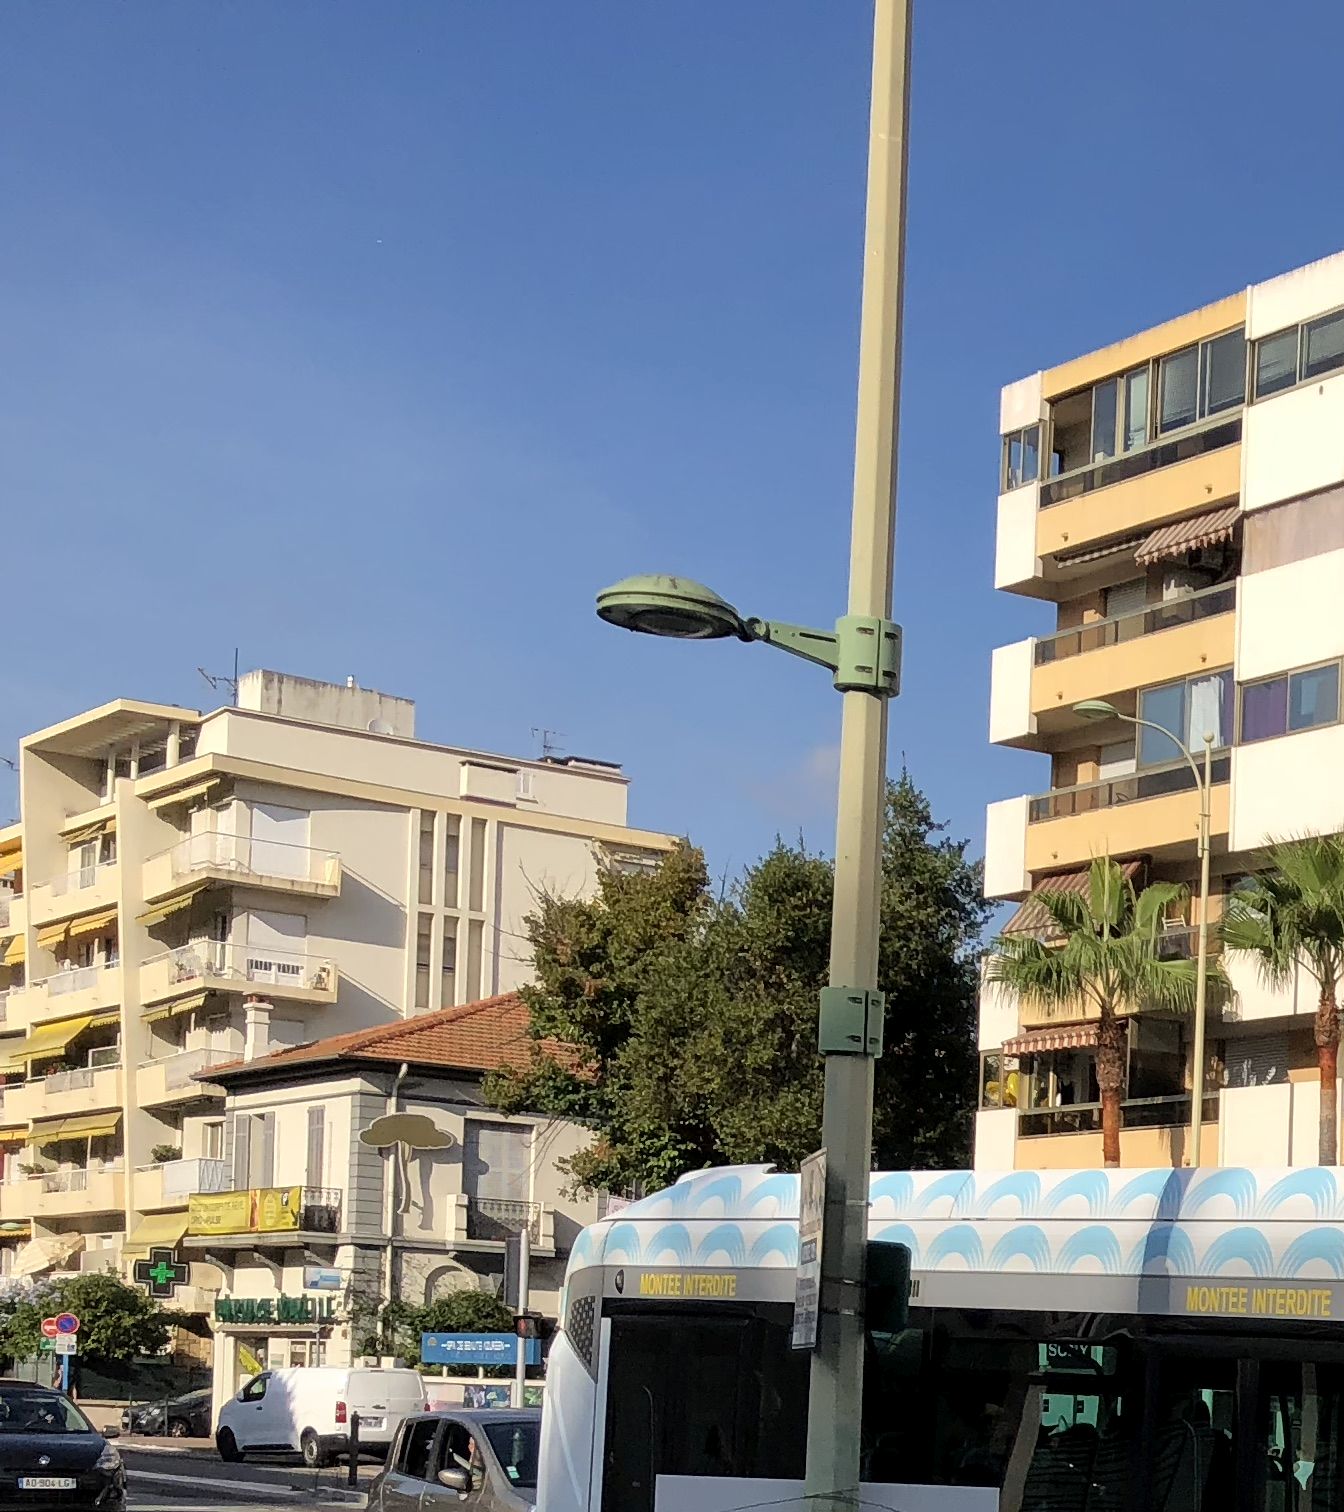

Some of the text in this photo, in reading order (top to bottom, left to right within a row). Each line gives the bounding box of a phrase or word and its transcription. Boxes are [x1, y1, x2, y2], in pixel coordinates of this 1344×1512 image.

[640, 1273, 737, 1297] MONTEE INTERDITE
[1186, 1285, 1332, 1317] MONTEE INTERDITE
